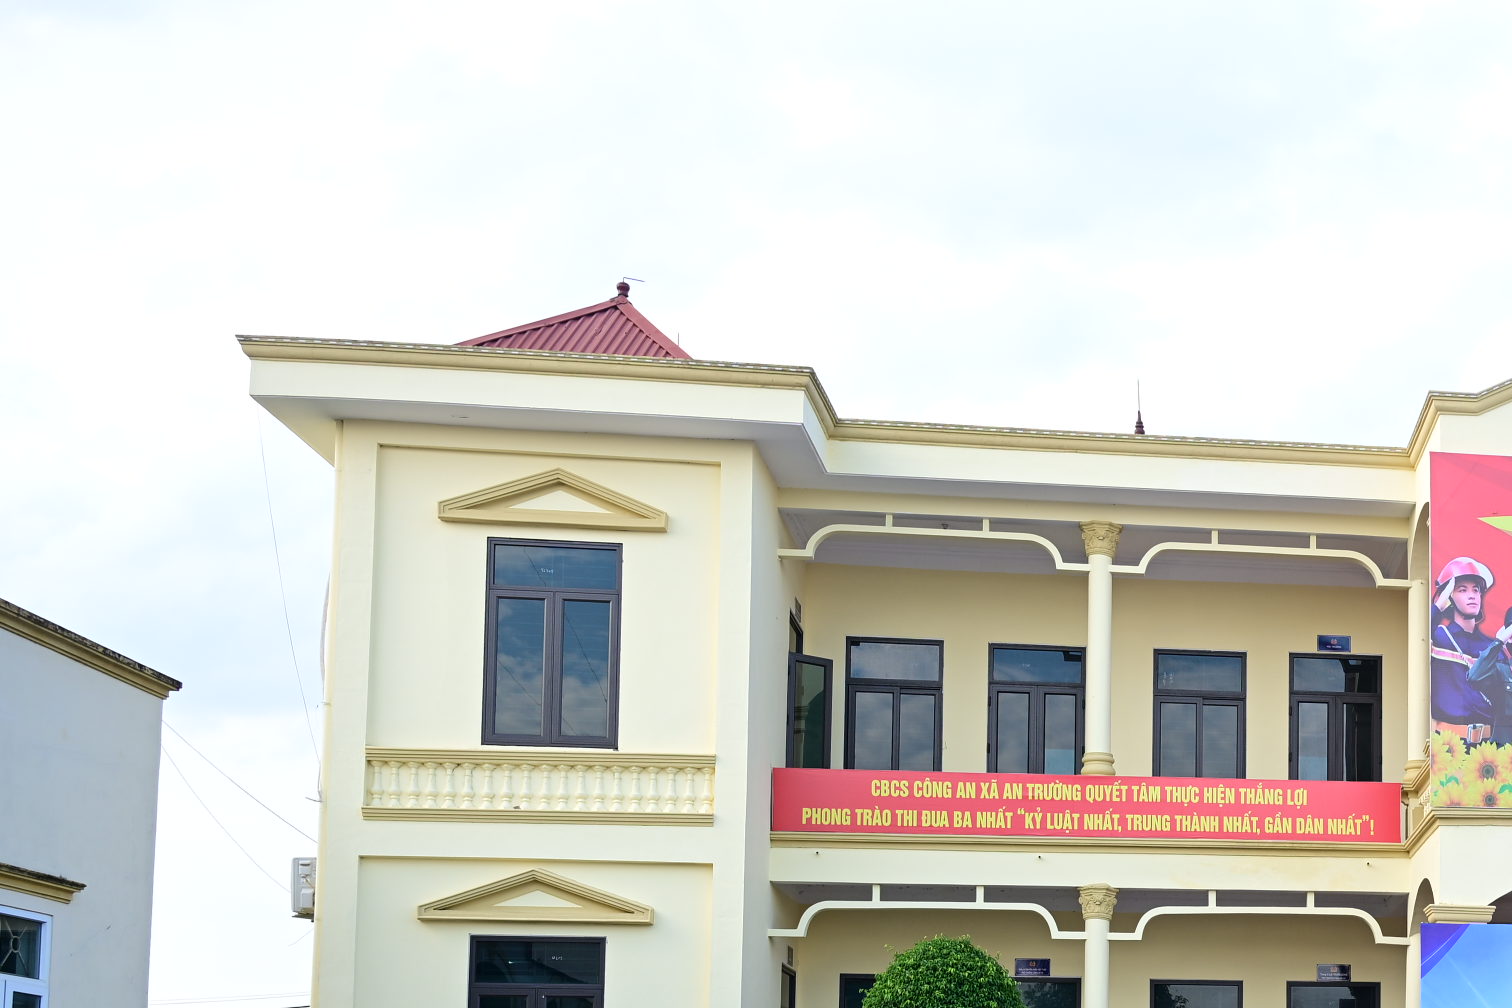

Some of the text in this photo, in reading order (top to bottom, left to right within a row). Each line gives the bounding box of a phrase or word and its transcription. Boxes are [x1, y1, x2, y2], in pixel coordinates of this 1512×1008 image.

[871, 778, 1308, 809] CBCS CÔNG AN XÃ AN TRƯỜNG QUYẾT TÂM THỰC HIỆN THẮNG LỢI
[802, 807, 851, 826] PHONG
[855, 806, 892, 827] TRÀO
[896, 810, 918, 827] THI
[921, 810, 949, 828] ĐUA
[953, 811, 973, 828] BA
[976, 806, 1013, 829] NHẤT
[1017, 807, 1043, 830] “KỶ
[1047, 810, 1080, 833] LUẬT
[1084, 808, 1122, 833] NHẤT,
[1126, 815, 1171, 832] TRUNG
[1175, 812, 1219, 833] THÀNH
[1223, 811, 1260, 835] NHẤT,
[1265, 812, 1293, 834] GẦN
[1296, 815, 1324, 835] DÂN
